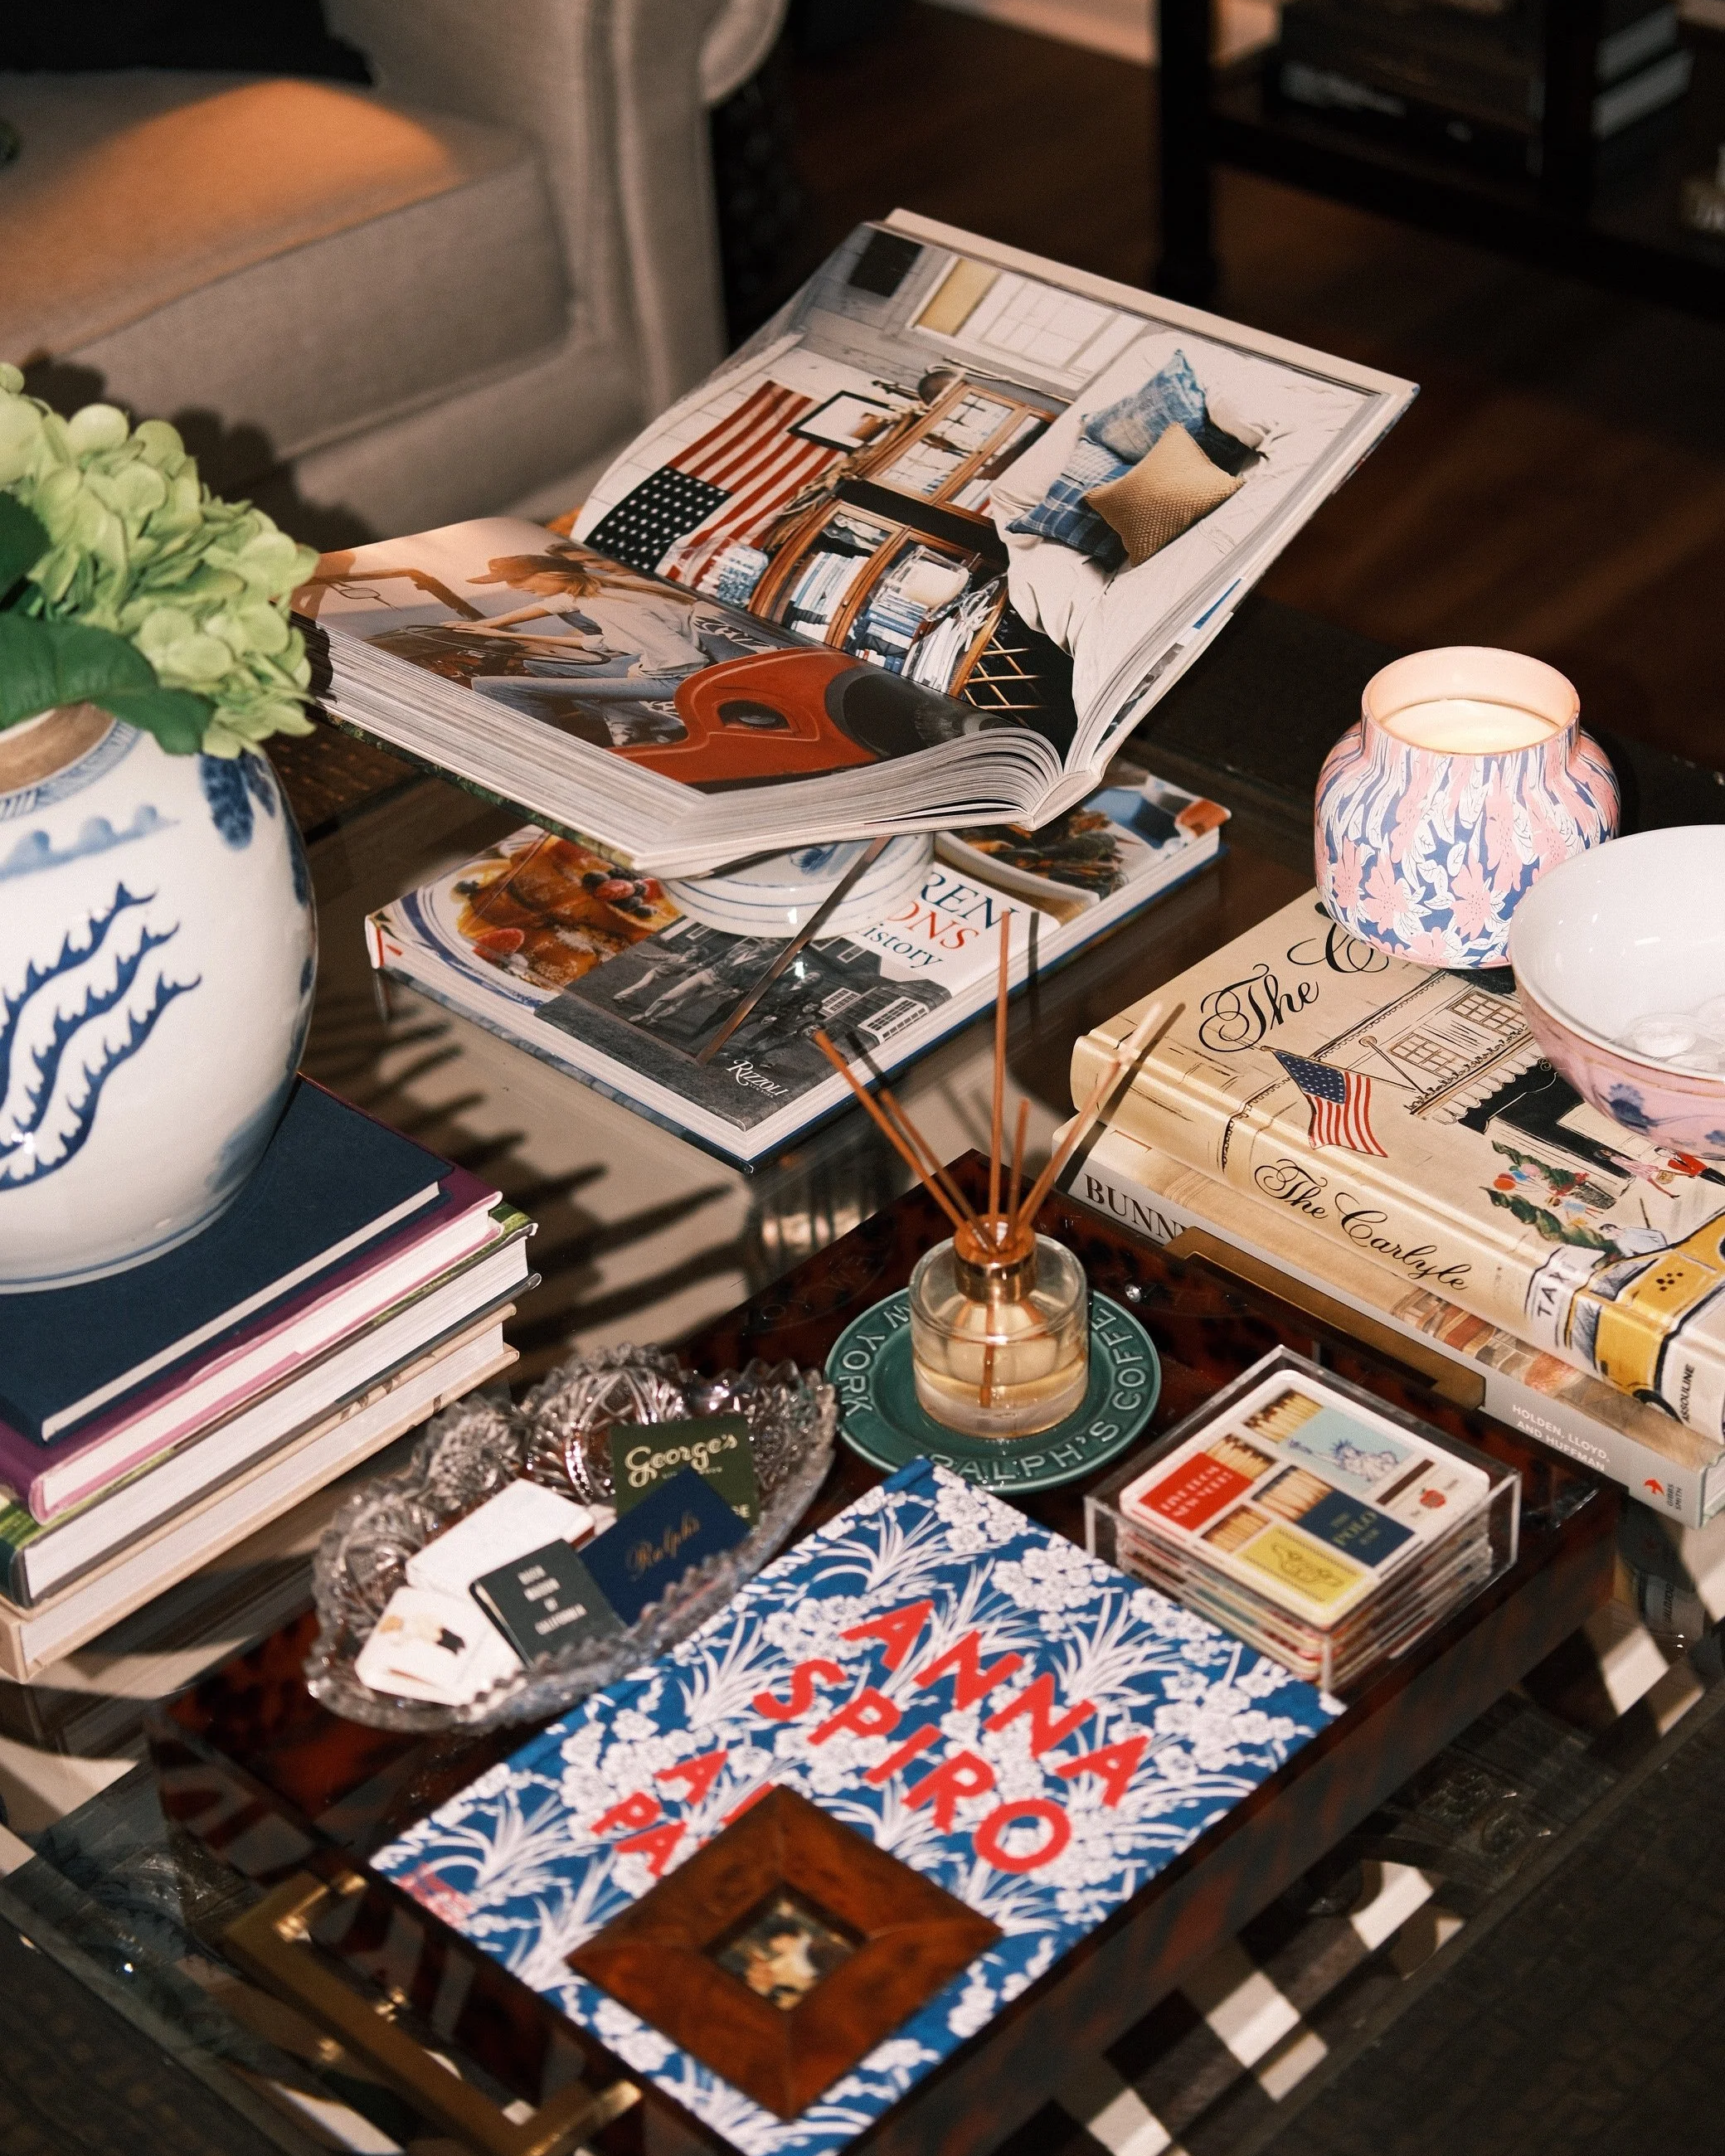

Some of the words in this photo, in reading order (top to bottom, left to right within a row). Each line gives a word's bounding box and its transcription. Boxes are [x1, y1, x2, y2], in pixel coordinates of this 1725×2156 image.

[921, 872, 1021, 930] REN
[861, 922, 944, 969] istory
[1198, 963, 1319, 1052] The
[726, 1059, 790, 1096] RIZZOLI
[1084, 1173, 1188, 1240] BUNN
[1254, 1158, 1329, 1220] The
[1334, 1192, 1473, 1291] Carlyle
[838, 1334, 887, 1417] YORK
[1091, 1308, 1146, 1411] COFFE
[1680, 1363, 1696, 1425] ASSOULINE
[624, 1434, 738, 1488] George's
[1516, 1420, 1543, 1440] AND
[1545, 1435, 1606, 1473] HUFFMAN
[1665, 1483, 1675, 1507] GIBBS
[838, 1598, 1151, 1809] ANNA
[752, 1658, 1073, 1874] SPIRO
[590, 1790, 689, 1880] PA
